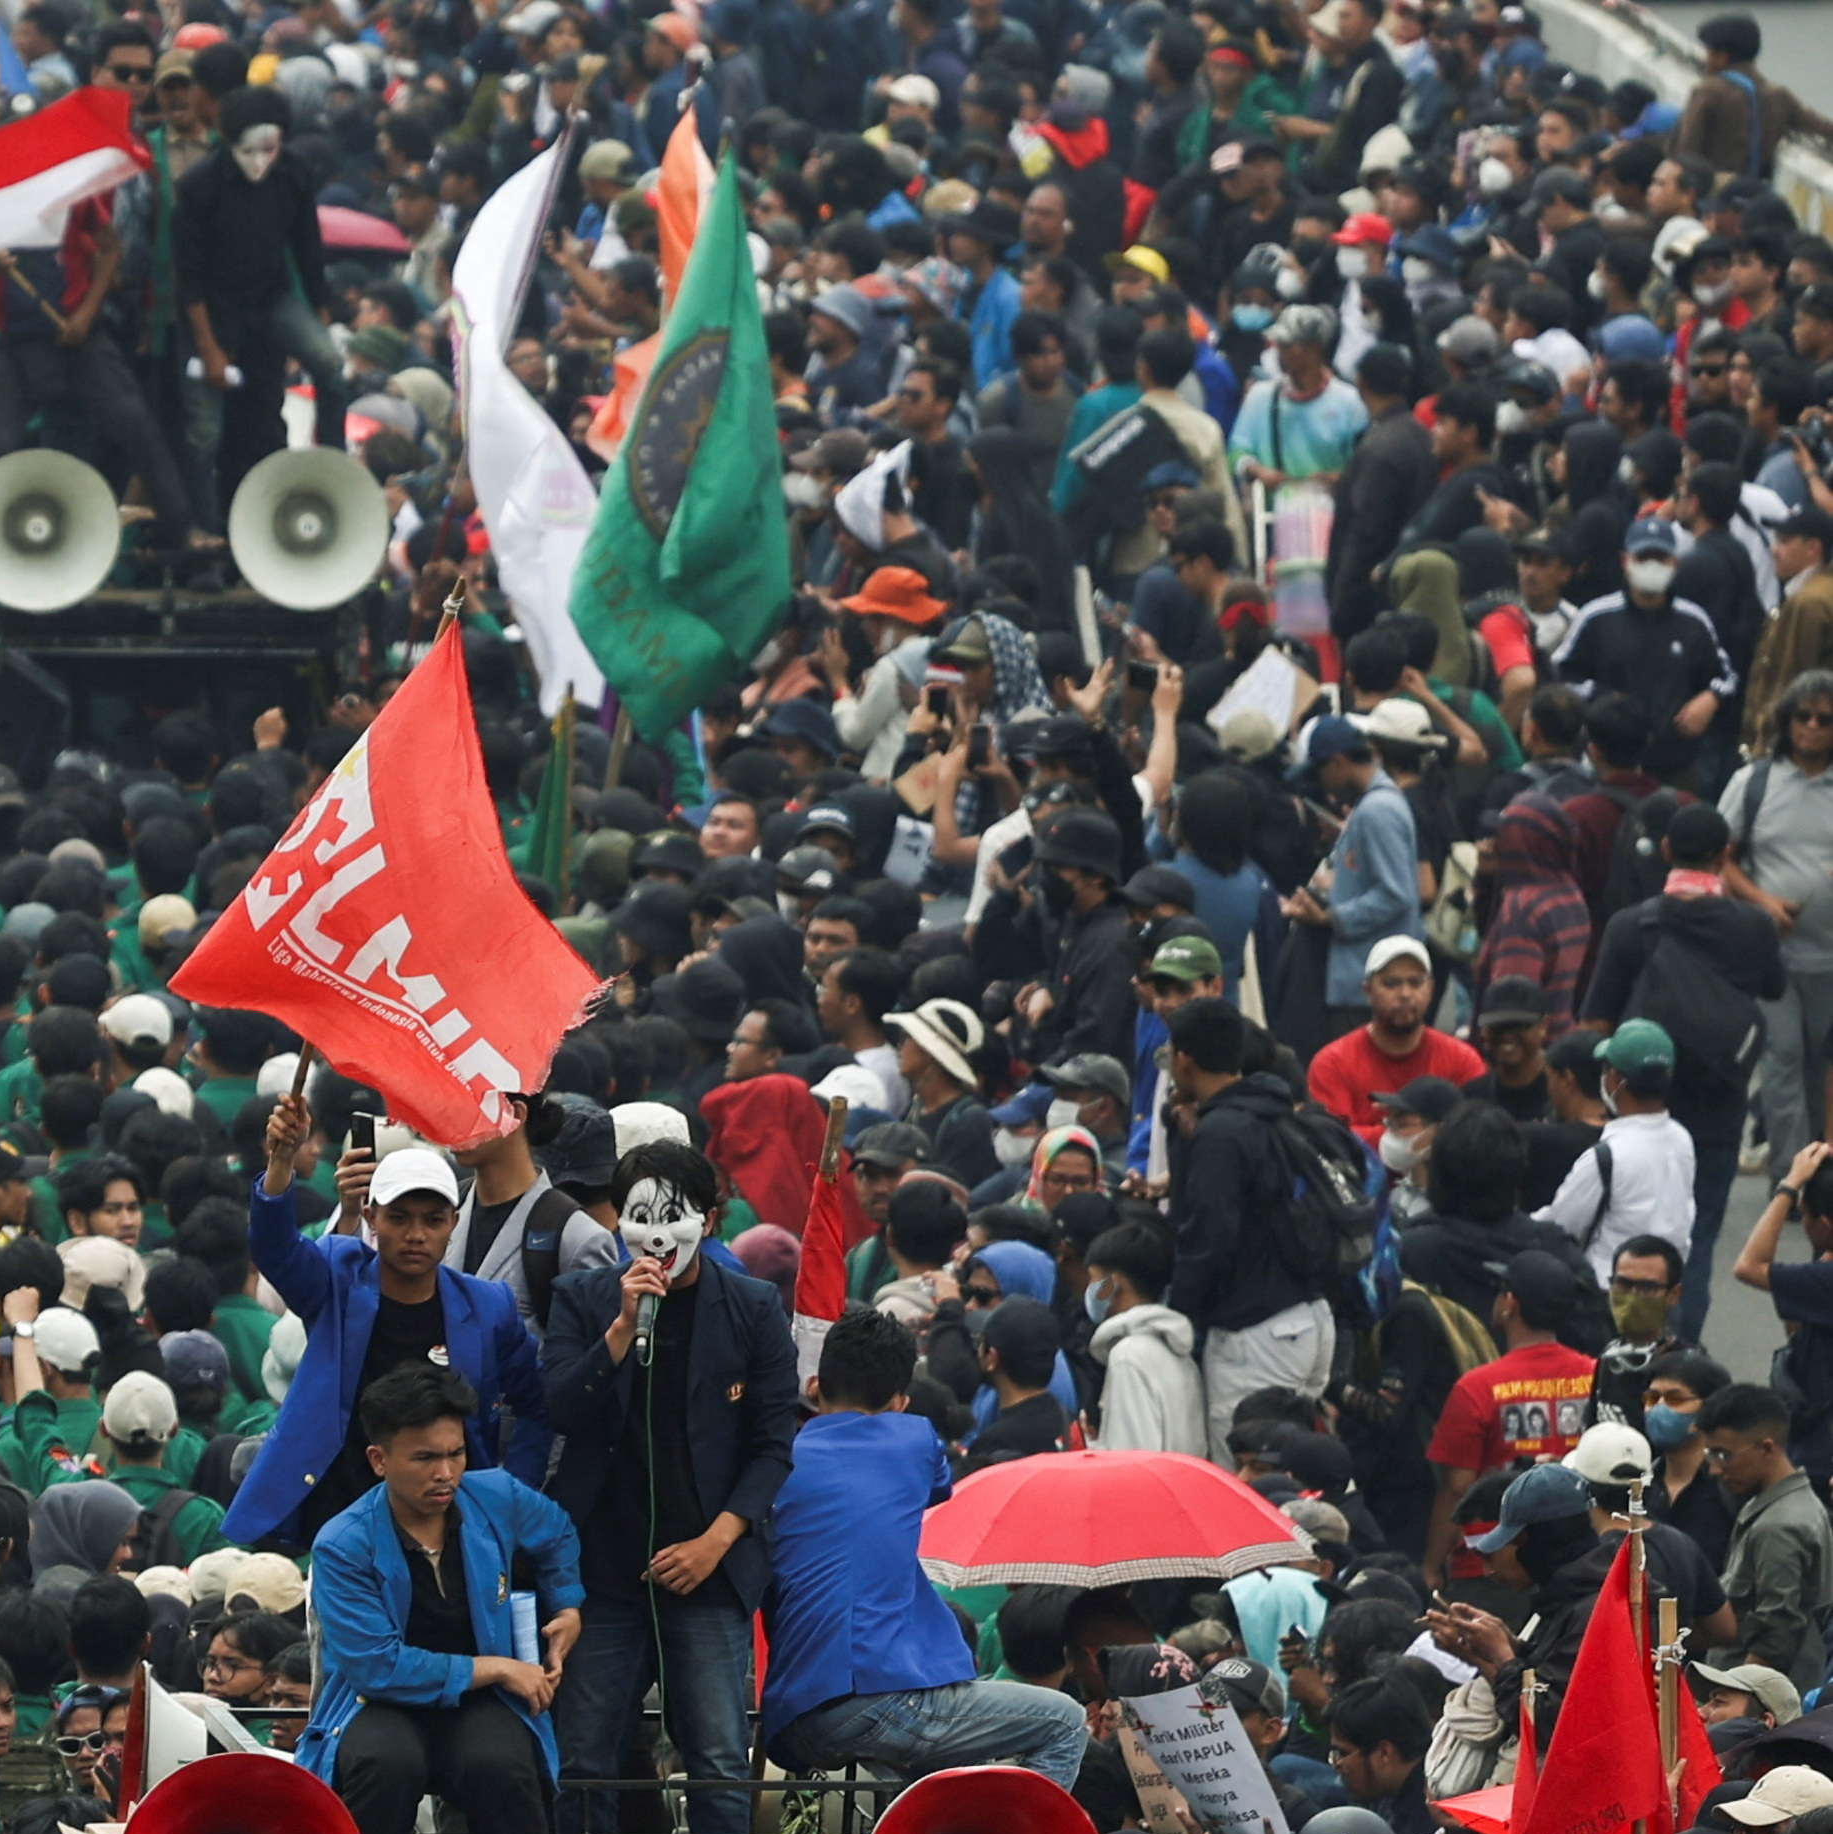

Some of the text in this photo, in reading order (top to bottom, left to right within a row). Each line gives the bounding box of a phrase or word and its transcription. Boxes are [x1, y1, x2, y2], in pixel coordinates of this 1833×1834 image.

[266, 937, 290, 972] Liga
[292, 958, 359, 1003] Mahasiswa
[358, 995, 418, 1036] Indonesia
[414, 1025, 445, 1065] untuk
[1179, 1719, 1226, 1741] Militer
[1159, 1740, 1236, 1765] dari PAPUA
[1181, 1767, 1231, 1785] Mereka
